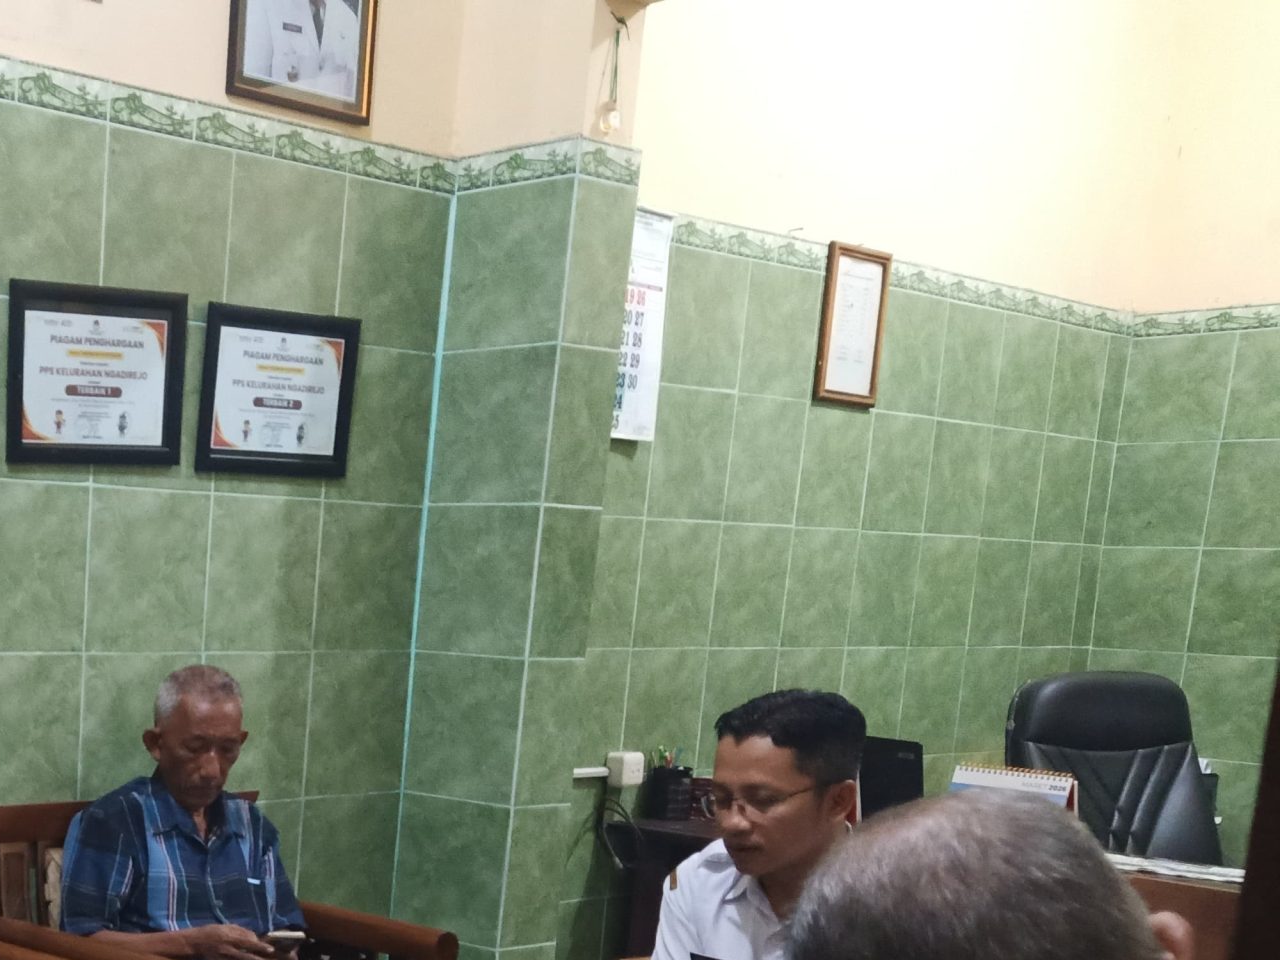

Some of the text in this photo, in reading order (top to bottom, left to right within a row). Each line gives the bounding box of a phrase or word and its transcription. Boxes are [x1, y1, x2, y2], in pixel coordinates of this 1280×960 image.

[634, 310, 645, 327] 27
[50, 334, 145, 349] PIAGAM PENGHARGAAN
[629, 352, 641, 369] 29
[56, 367, 102, 378] KELURAHAN
[627, 373, 639, 390] 30
